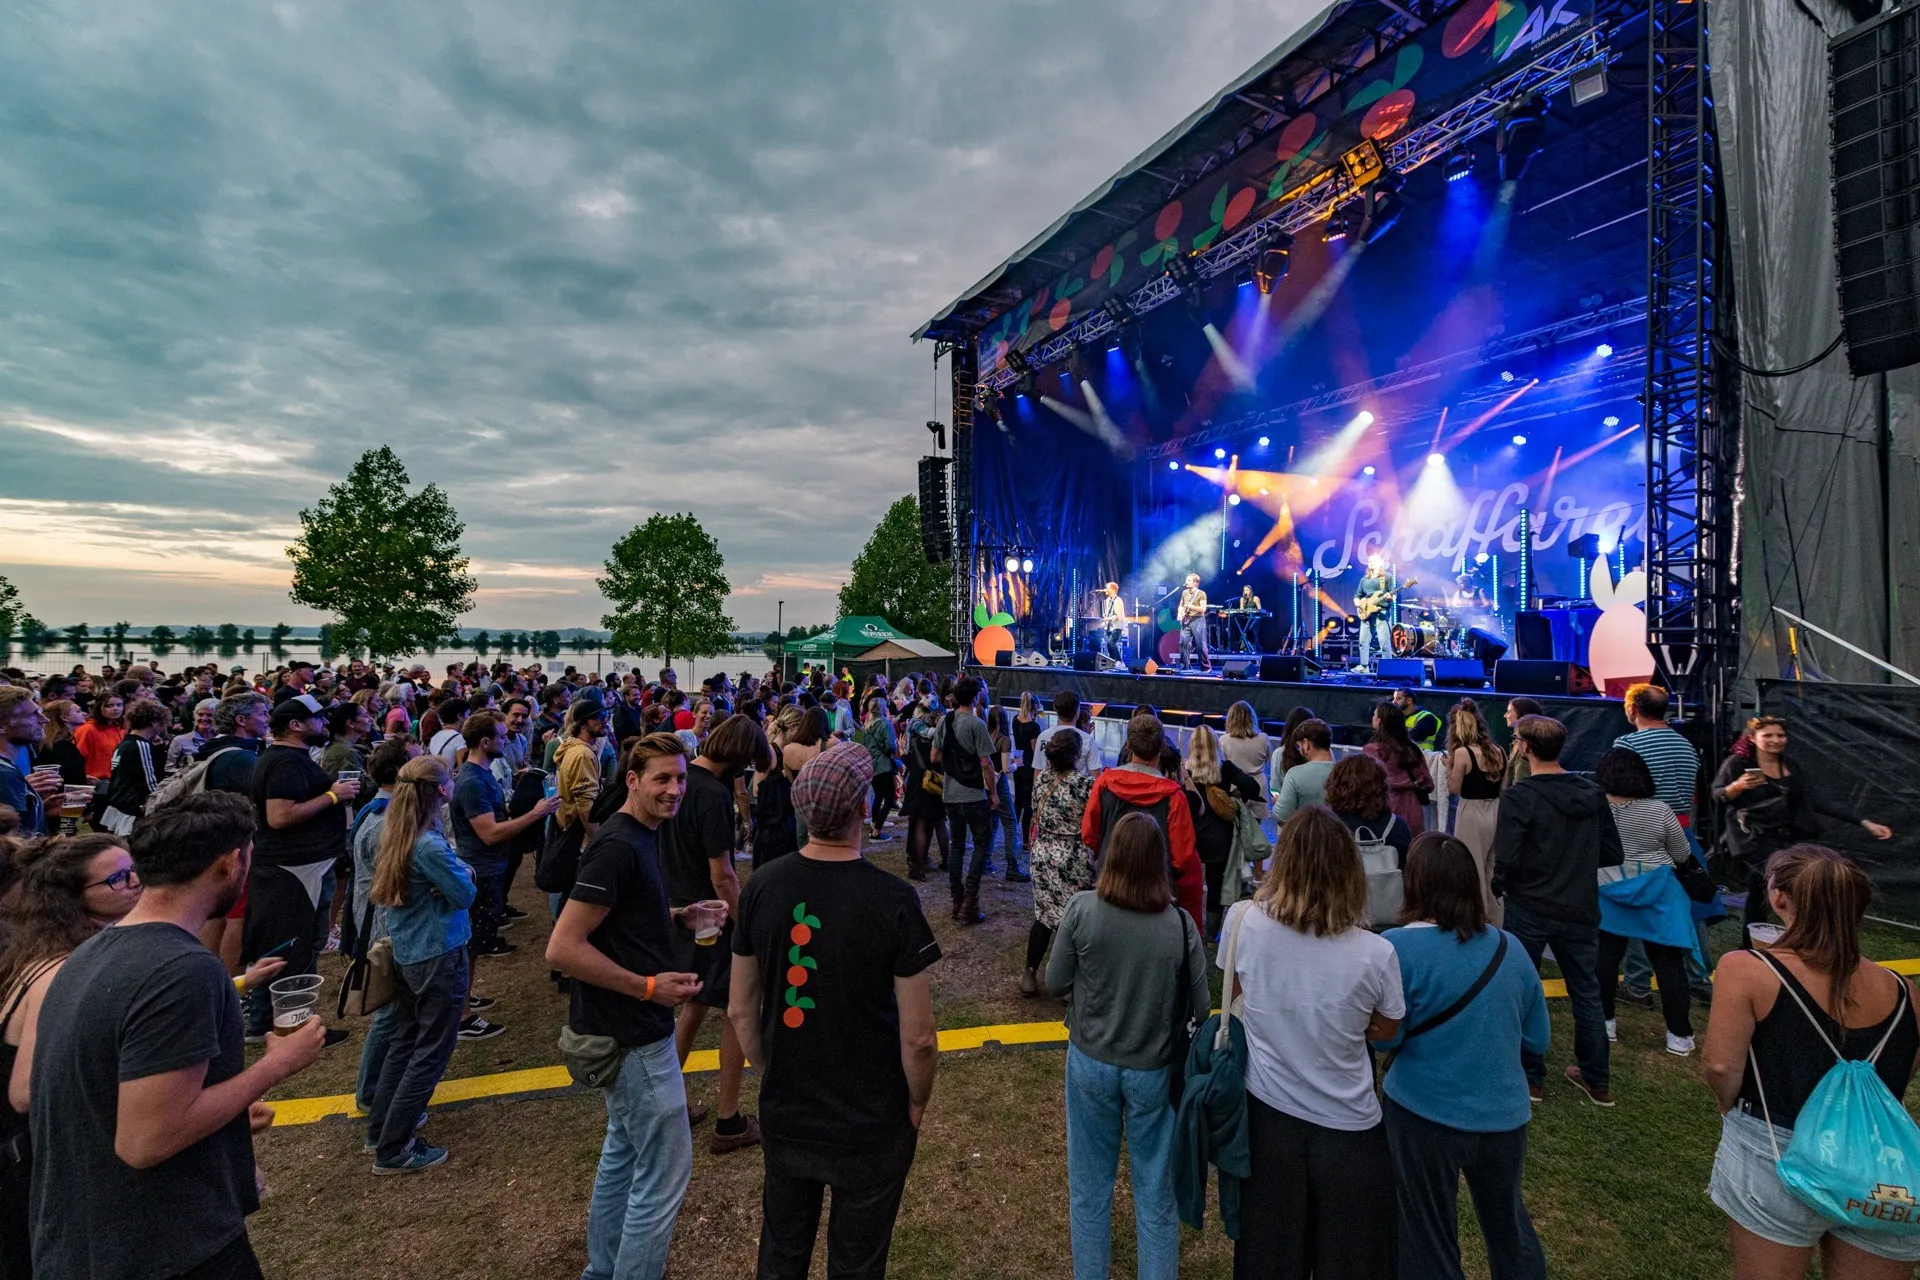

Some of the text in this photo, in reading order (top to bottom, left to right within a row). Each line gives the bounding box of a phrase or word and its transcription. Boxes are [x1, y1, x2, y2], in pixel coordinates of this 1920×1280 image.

[1530, 19, 1581, 51] VORARLBERG
[1312, 482, 1673, 578] Schaffare
[1846, 1198, 1920, 1224] PUEBL
